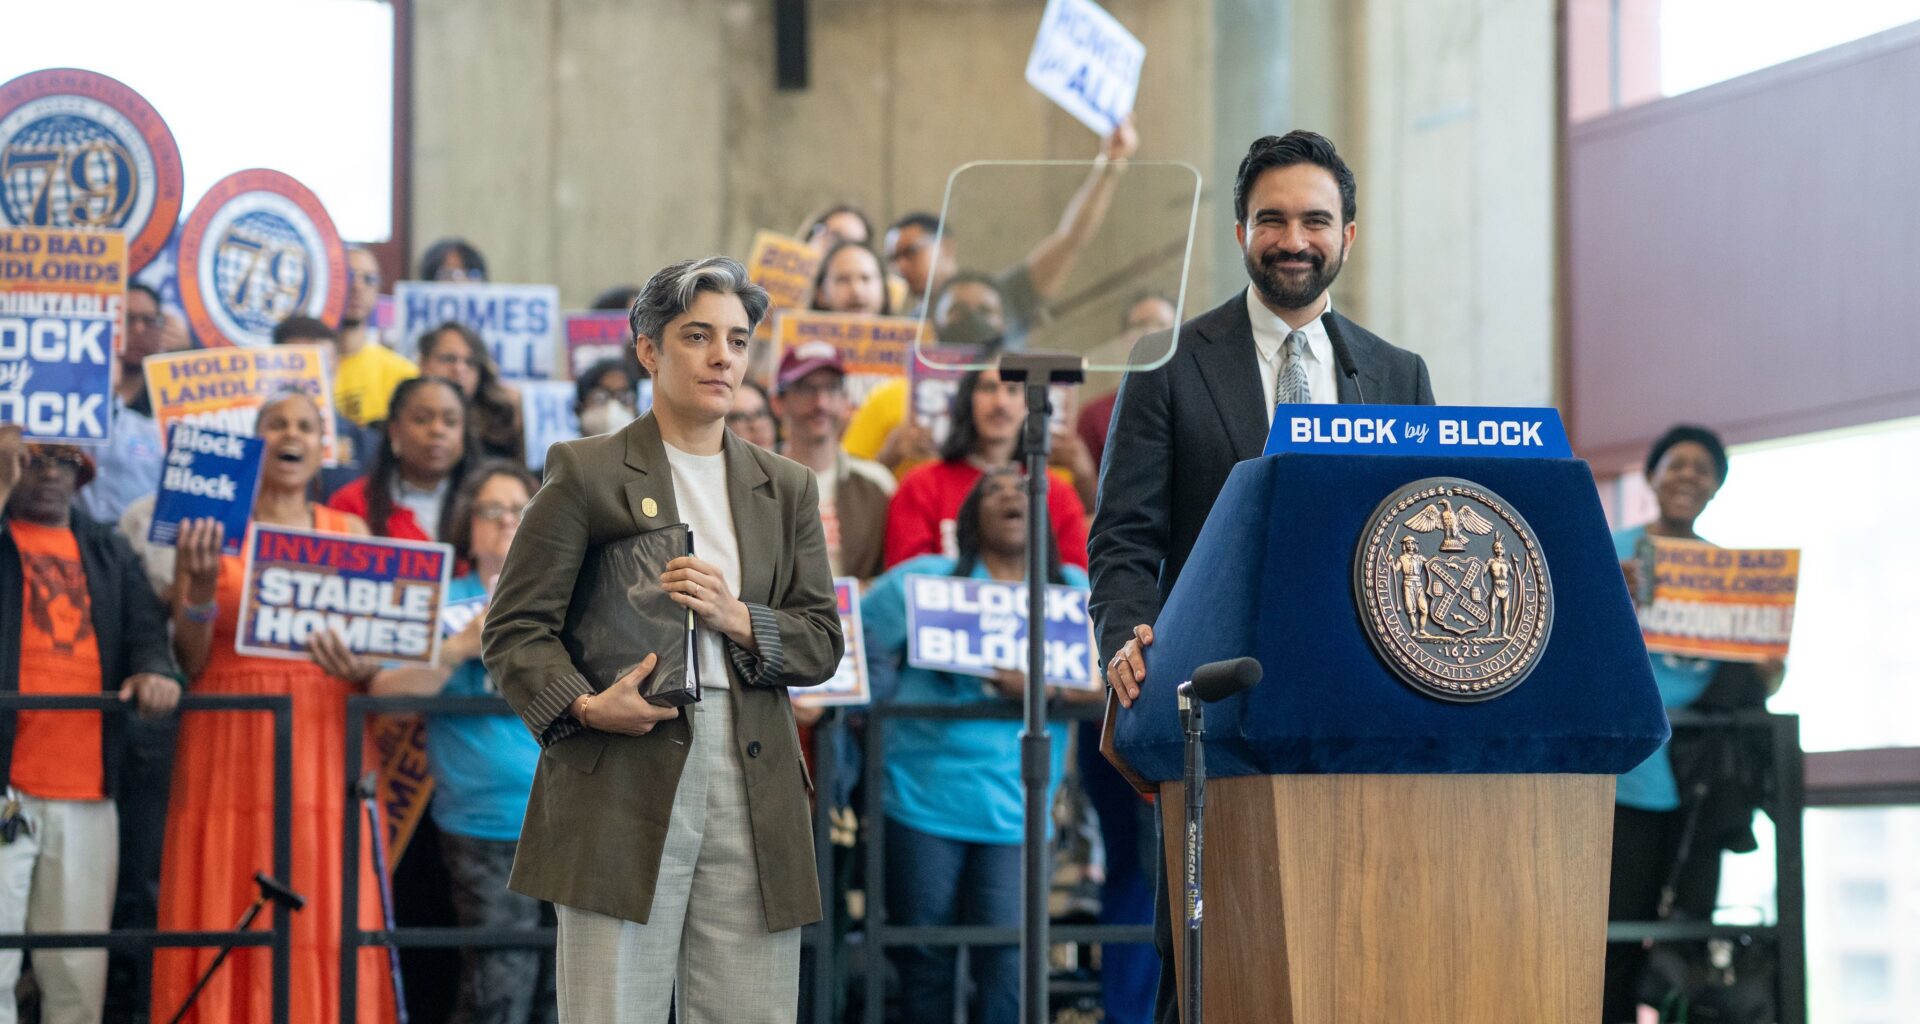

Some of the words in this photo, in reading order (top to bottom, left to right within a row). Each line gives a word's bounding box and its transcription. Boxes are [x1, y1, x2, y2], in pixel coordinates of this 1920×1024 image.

[3, 142, 137, 226] 79
[47, 235, 107, 256] BAD
[0, 260, 120, 284] DLORDS
[223, 226, 311, 321] 79
[404, 292, 550, 334] HOMES
[169, 354, 249, 380] HOLD
[255, 352, 306, 371] BAD
[490, 342, 550, 378] LL
[172, 424, 245, 460] Block
[1290, 417, 1398, 444] BLOCK
[1404, 421, 1430, 443] by
[1438, 420, 1544, 447] BLOCK
[163, 466, 237, 501] Block
[259, 531, 396, 574] INVEST
[401, 548, 441, 578] IN
[259, 566, 434, 621] STABLE
[255, 604, 429, 657] HOMES
[1405, 642, 1473, 679] CIVITATIS
[1480, 651, 1515, 676] NOVI
[1513, 588, 1536, 649] EBORACI
[1443, 645, 1480, 657] 1625
[1187, 820, 1197, 884] SAMSON
